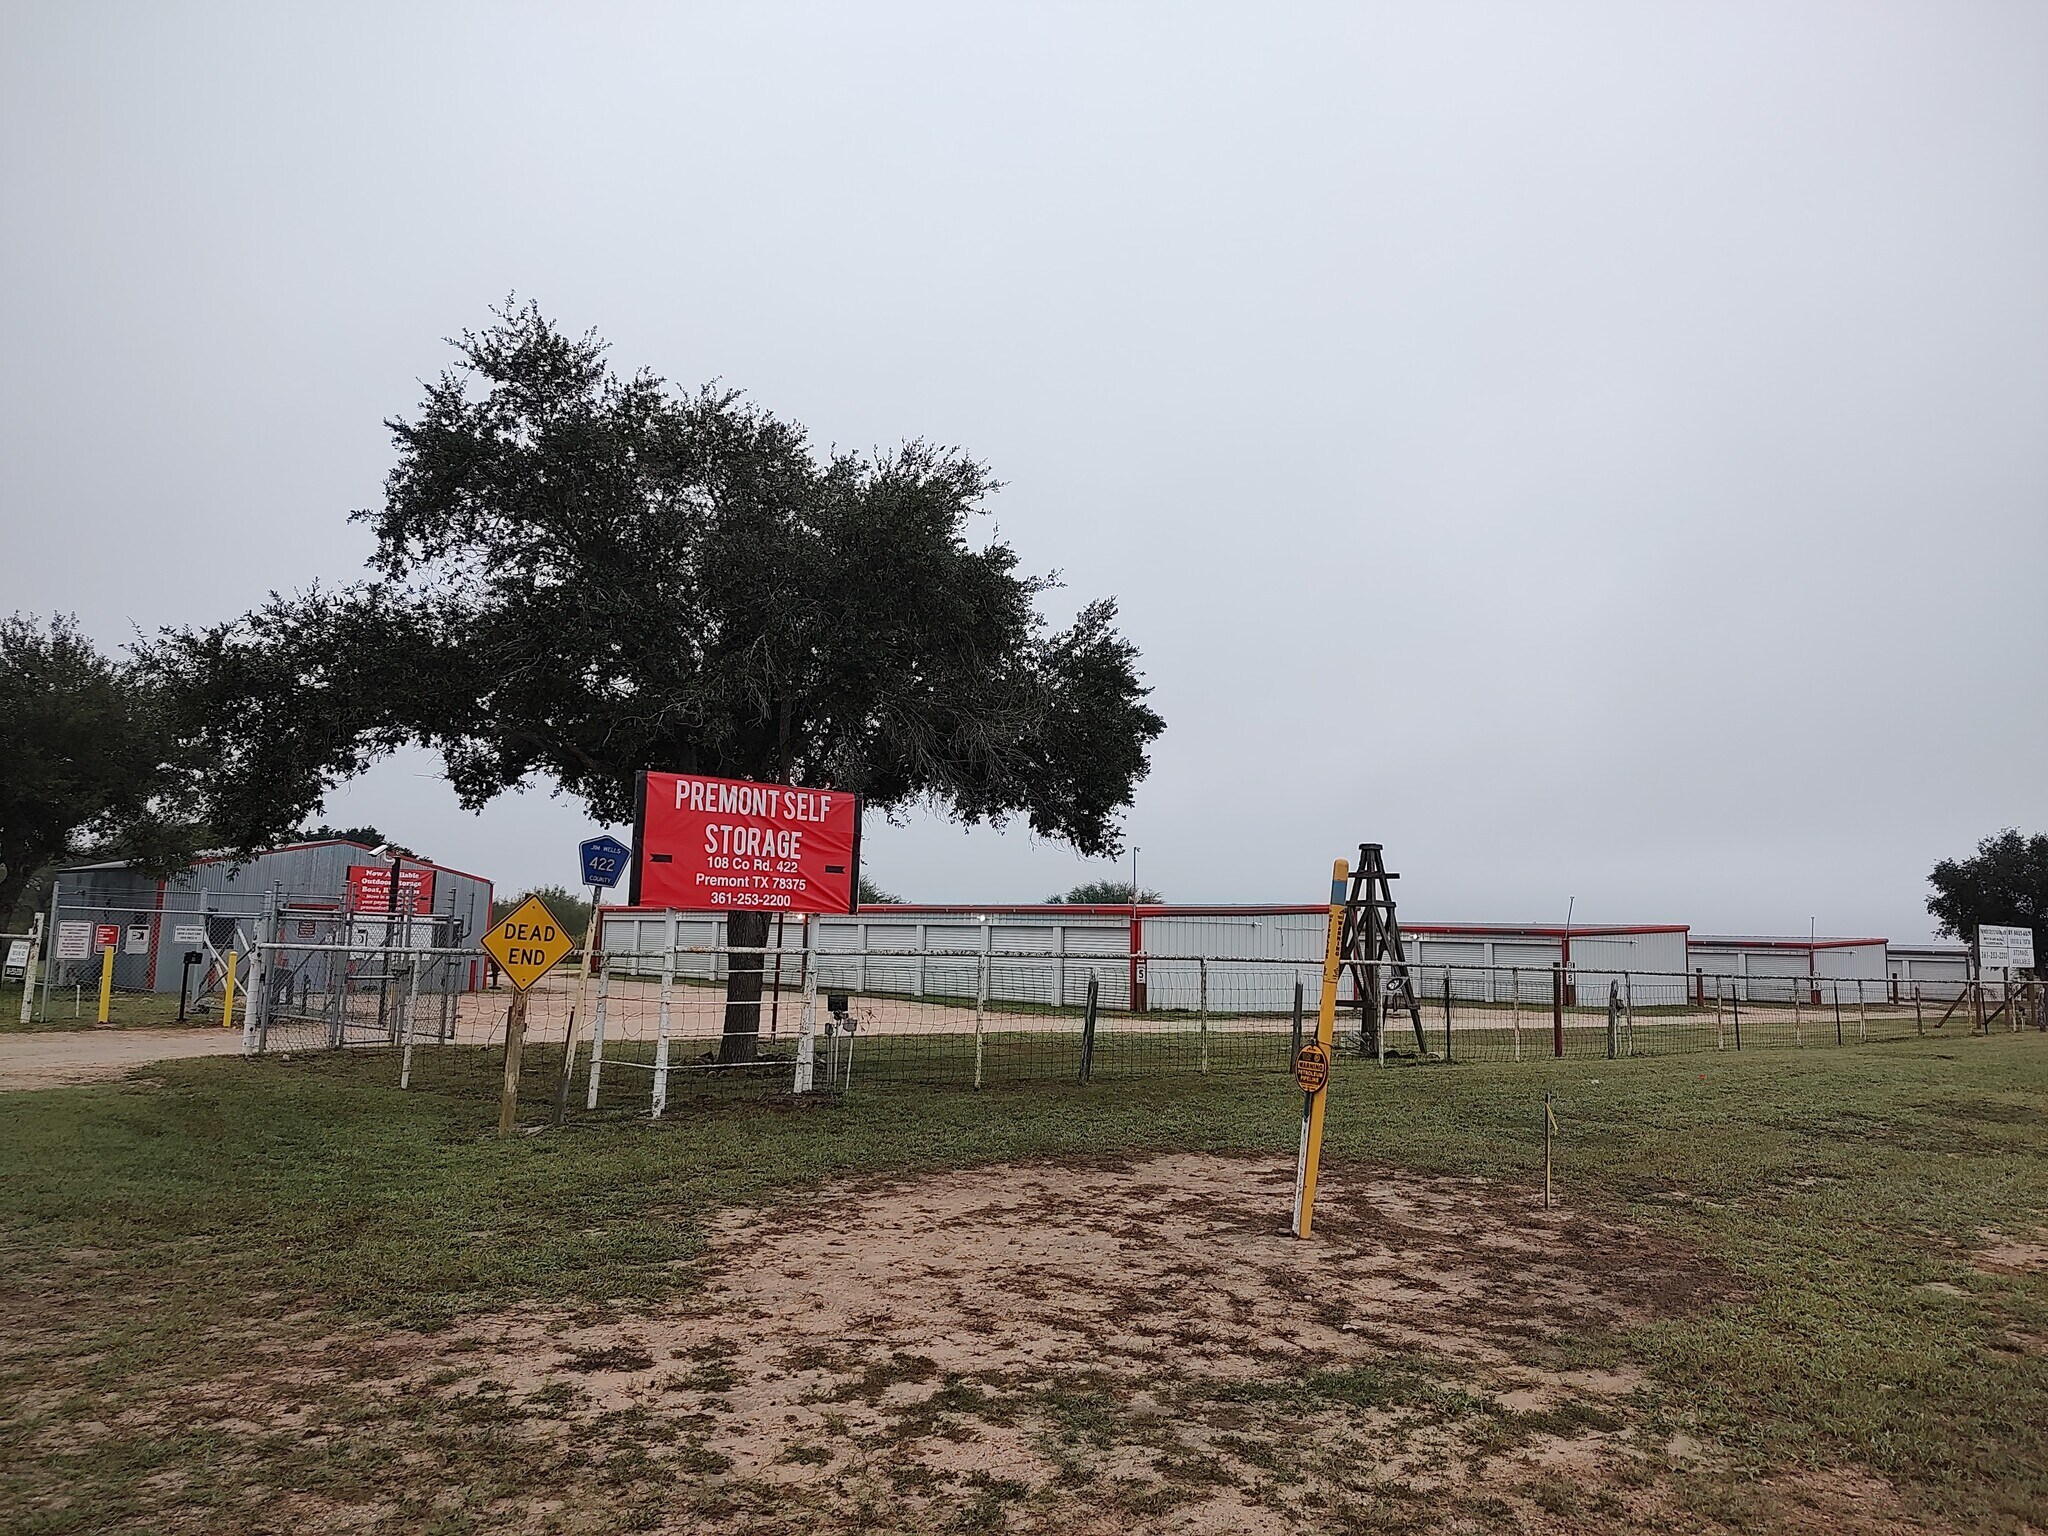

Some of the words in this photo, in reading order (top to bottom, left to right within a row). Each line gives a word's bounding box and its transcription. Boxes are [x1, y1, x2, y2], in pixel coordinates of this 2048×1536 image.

[675, 779, 780, 818] PREMONT
[783, 791, 832, 823] SELF
[603, 846, 622, 854] WELLS
[704, 823, 803, 860] STORAGE
[589, 856, 615, 872] 422
[707, 856, 729, 870] 108
[732, 857, 750, 871] Co
[753, 858, 773, 872] Rd.
[776, 861, 798, 873] 422
[589, 875, 612, 884] COUNTY
[695, 873, 750, 888] Premont
[752, 875, 769, 889] TX
[772, 877, 806, 891] 78375
[710, 892, 791, 907] 361-253-2200
[504, 923, 556, 942] DEAD
[508, 948, 545, 966] END
[1138, 969, 1144, 979] 5
